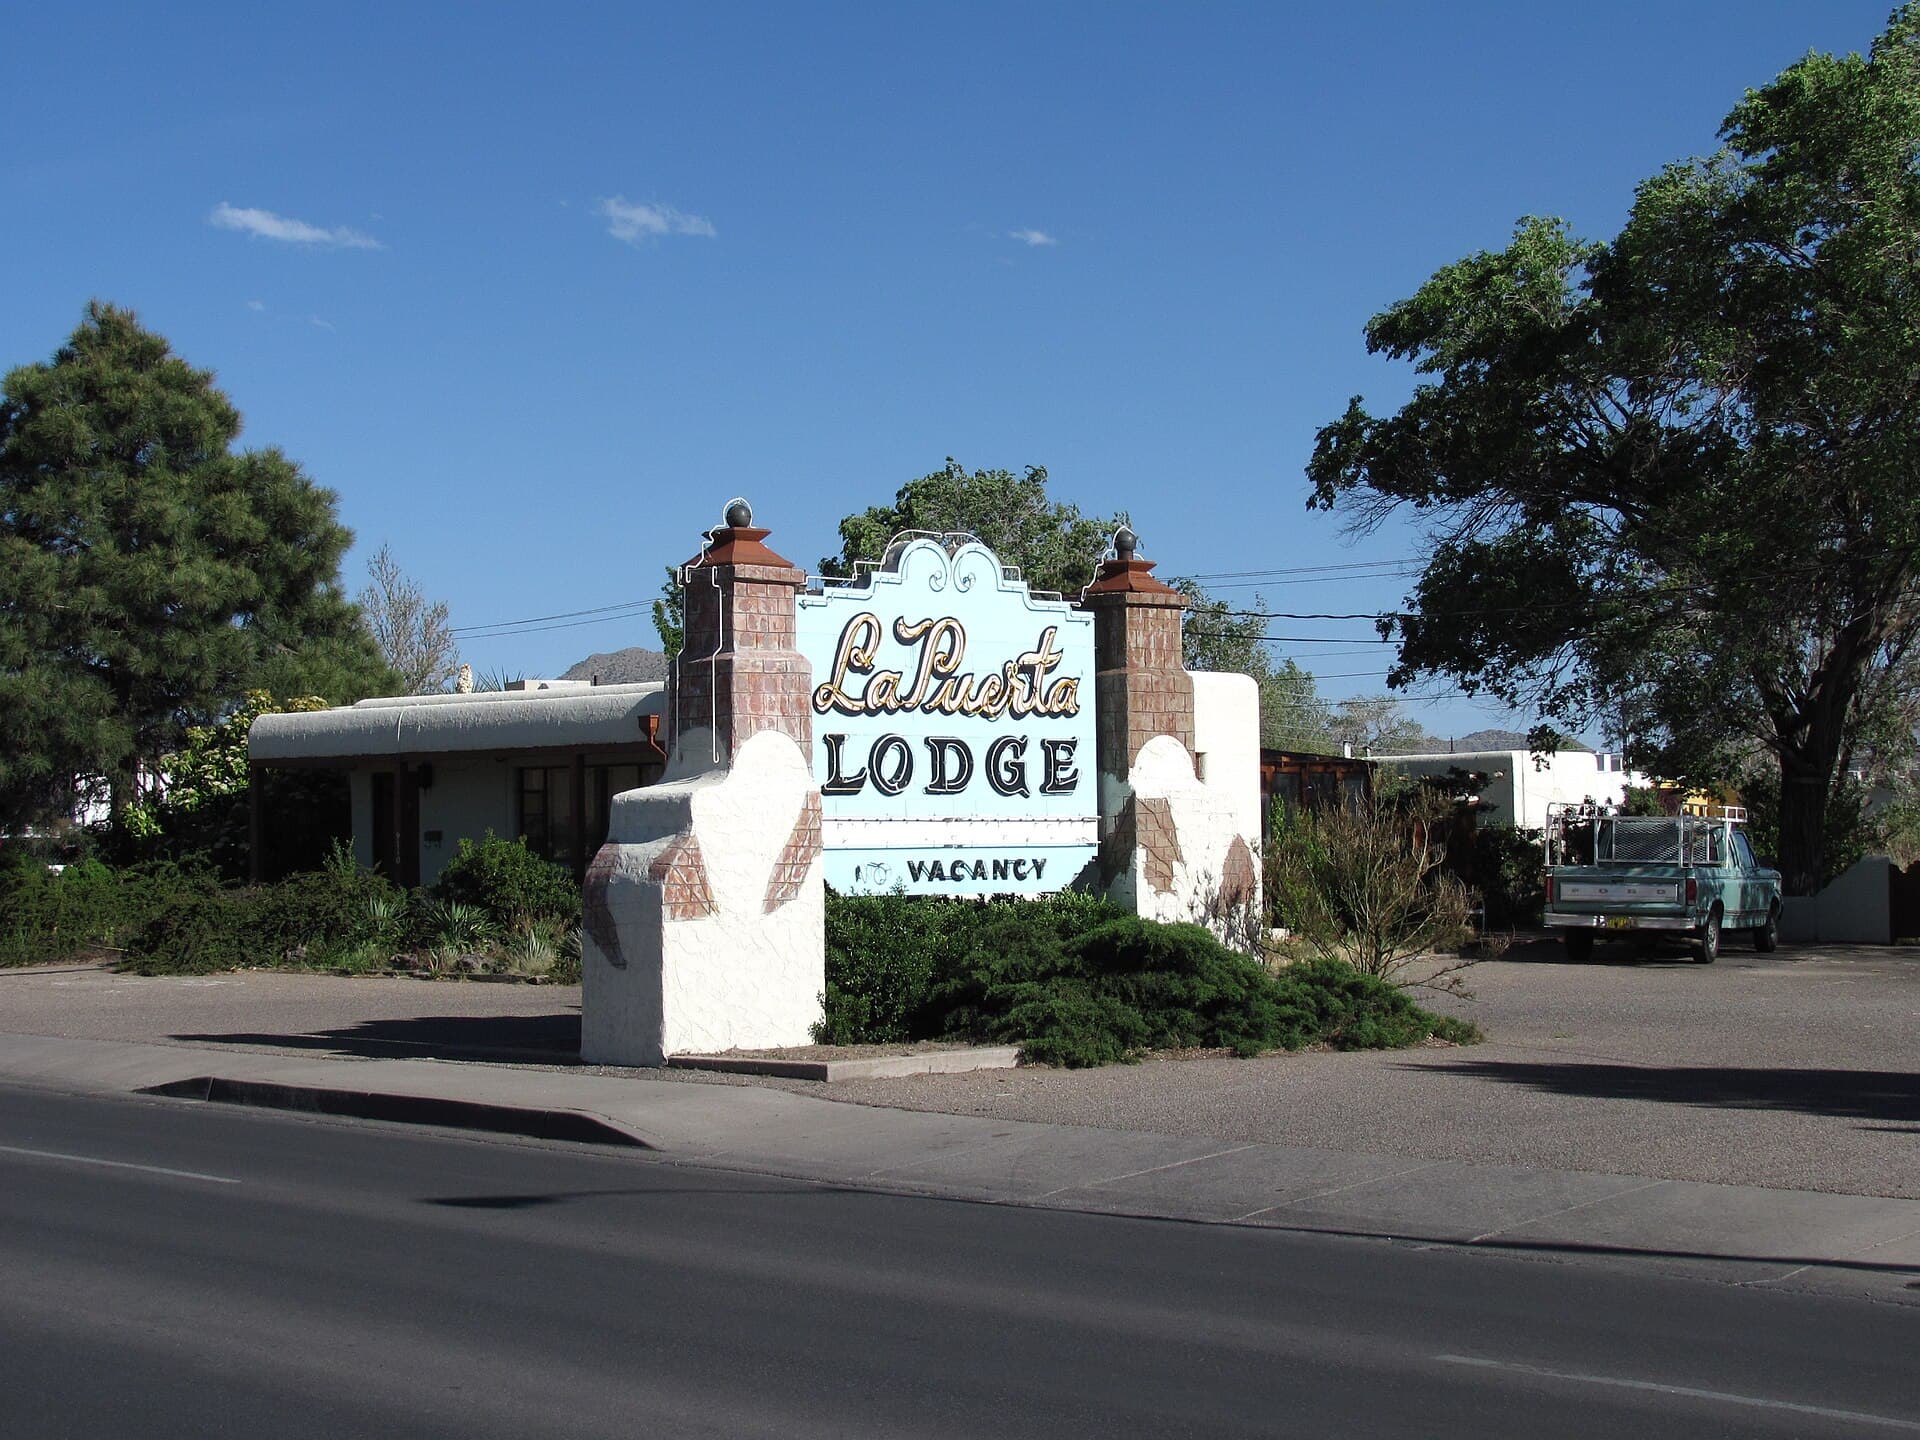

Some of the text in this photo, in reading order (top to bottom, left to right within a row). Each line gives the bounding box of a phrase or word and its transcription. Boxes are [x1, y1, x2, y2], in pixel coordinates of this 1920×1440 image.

[812, 611, 1081, 720] La Puerta
[821, 732, 1081, 798] LODGE
[908, 858, 1047, 882] VACANCY
[1571, 887, 1667, 896] FORD
